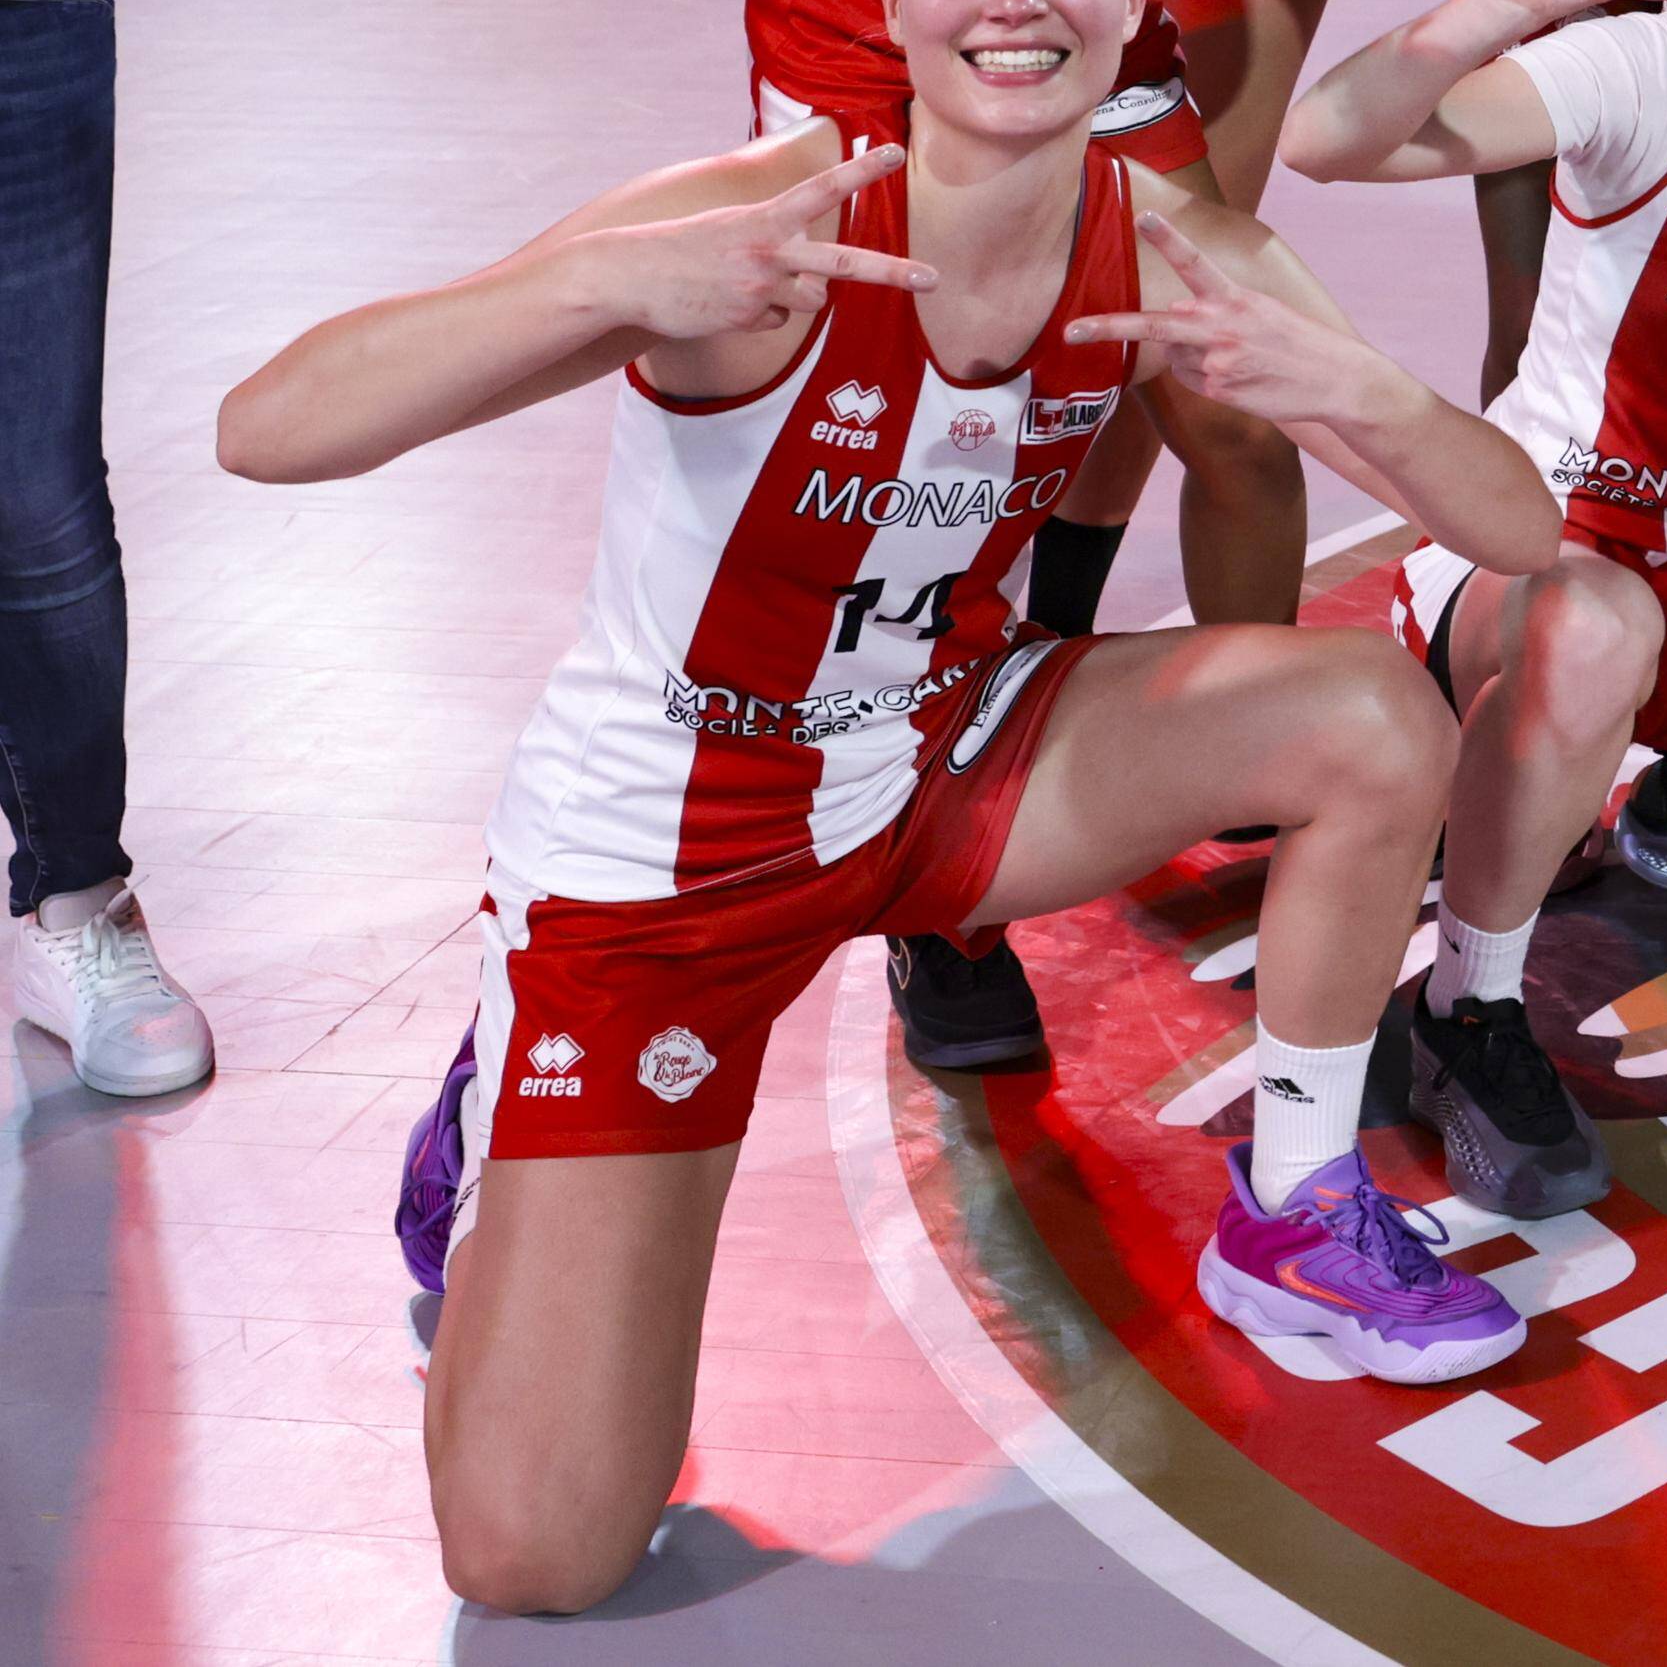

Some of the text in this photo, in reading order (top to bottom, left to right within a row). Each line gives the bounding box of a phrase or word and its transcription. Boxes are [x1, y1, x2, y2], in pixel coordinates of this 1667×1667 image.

[810, 420, 878, 451] errea
[949, 419, 996, 437] MBA
[793, 467, 1068, 527] MONACO
[832, 570, 968, 653] 14
[518, 1076, 582, 1098] errea
